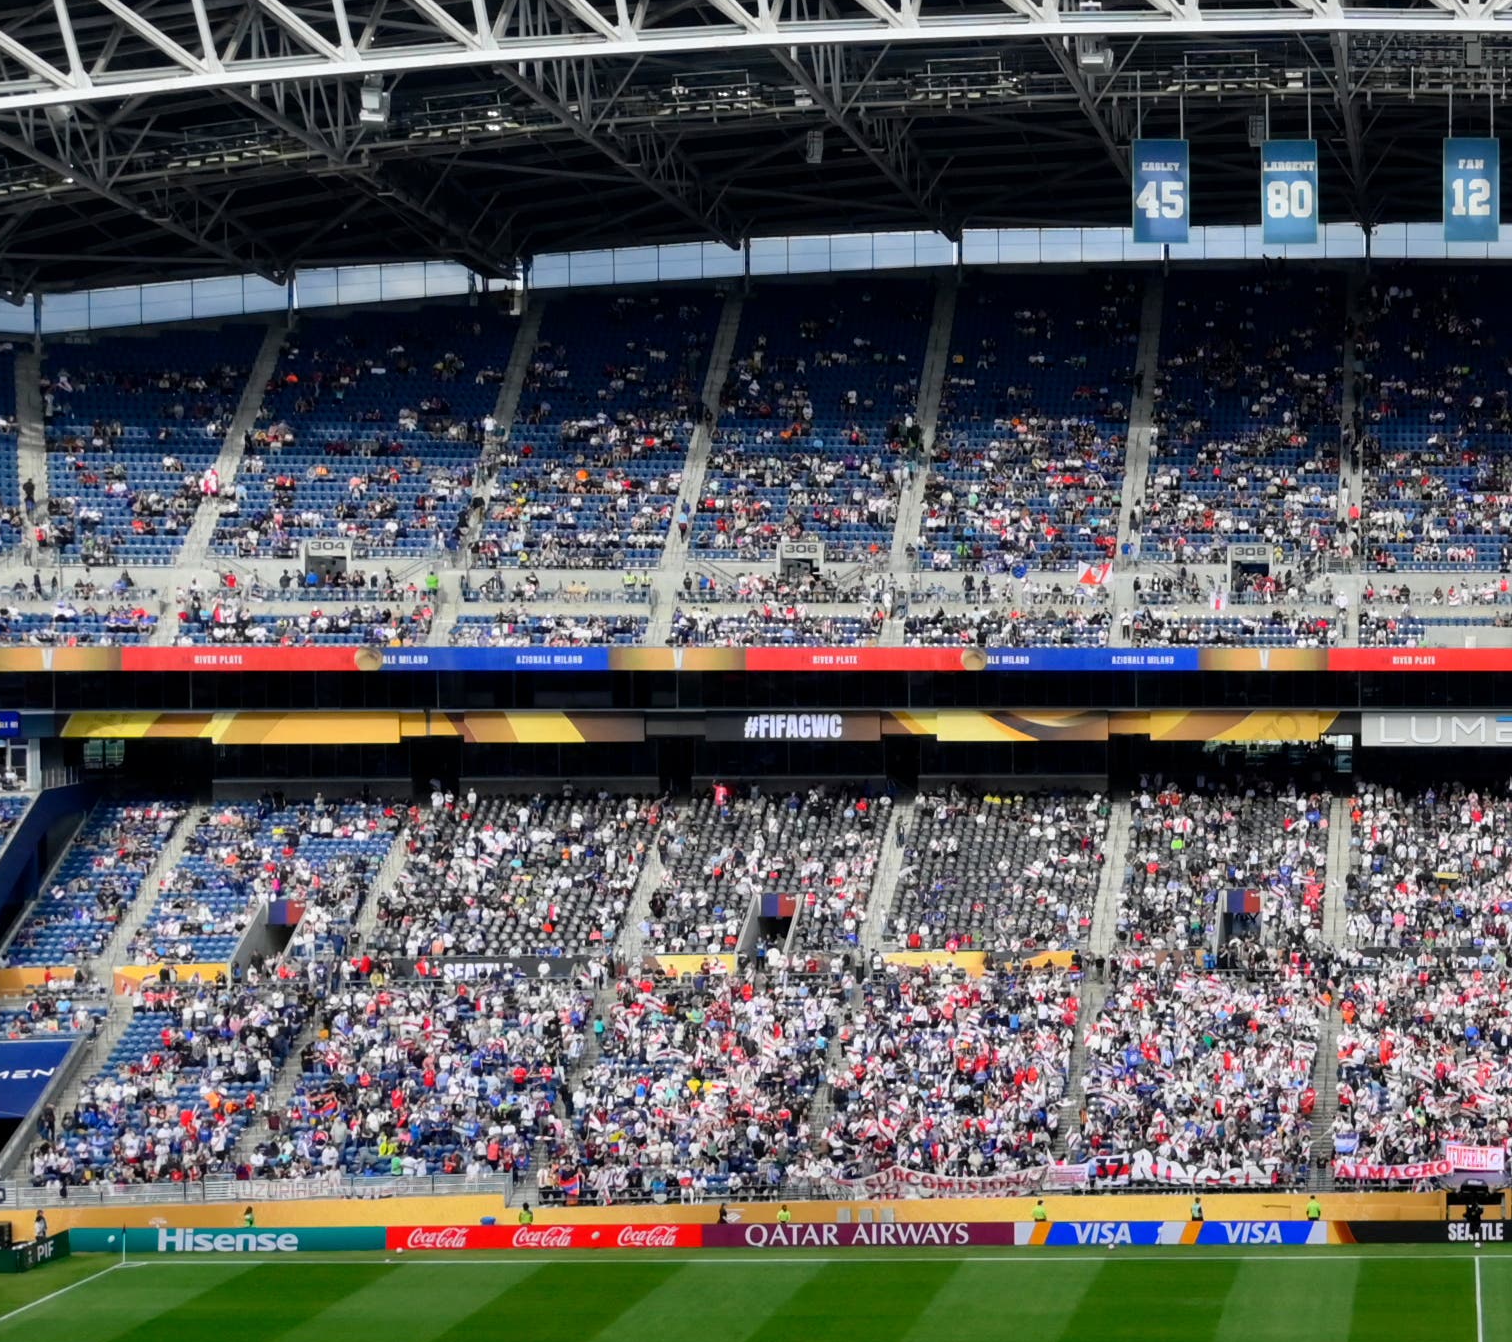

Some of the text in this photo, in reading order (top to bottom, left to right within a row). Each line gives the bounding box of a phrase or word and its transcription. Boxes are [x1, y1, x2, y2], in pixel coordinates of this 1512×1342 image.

[1458, 159, 1484, 170] FAN
[1136, 180, 1184, 219] 45
[1266, 180, 1313, 219] 80
[1451, 178, 1491, 216] 12
[310, 540, 347, 551] 304
[785, 544, 820, 555] 306
[1235, 546, 1269, 556] 308
[744, 714, 843, 739] #FIFACWC
[1337, 1161, 1451, 1179] ALMAGRO
[157, 1226, 299, 1253] Hisense
[745, 1222, 969, 1247] QATAR AIRWAYS
[1069, 1221, 1133, 1244] VISA
[1219, 1221, 1283, 1244] VISA
[36, 1240, 54, 1262] PIF
